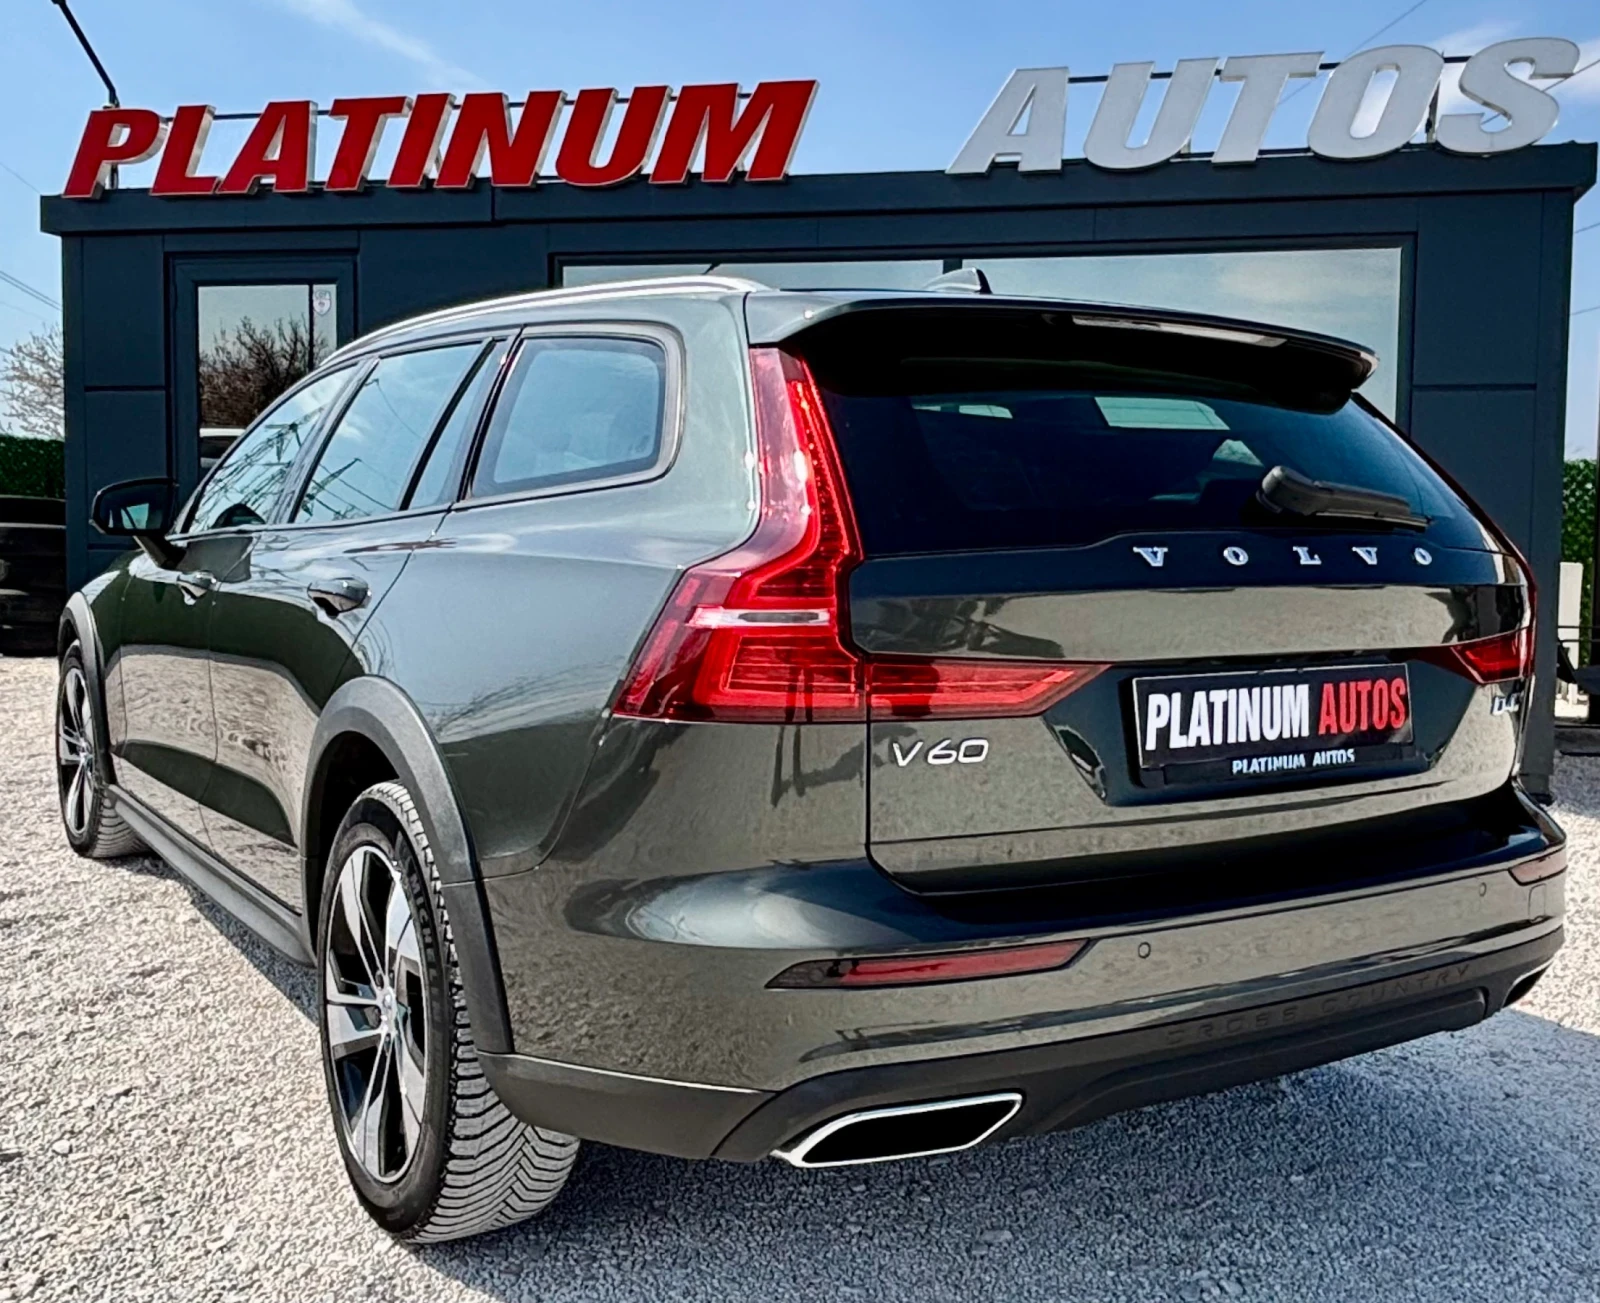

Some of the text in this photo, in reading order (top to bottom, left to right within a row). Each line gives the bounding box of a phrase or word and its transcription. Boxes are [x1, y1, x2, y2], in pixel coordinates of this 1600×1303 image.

[63, 37, 1580, 199] PLATINUM AUTOS
[1133, 546, 1433, 566] VOLVO
[1145, 677, 1407, 751] PLATINUM AUTOS
[892, 739, 989, 767] V60
[1231, 748, 1355, 774] PLATINUM AUTOS
